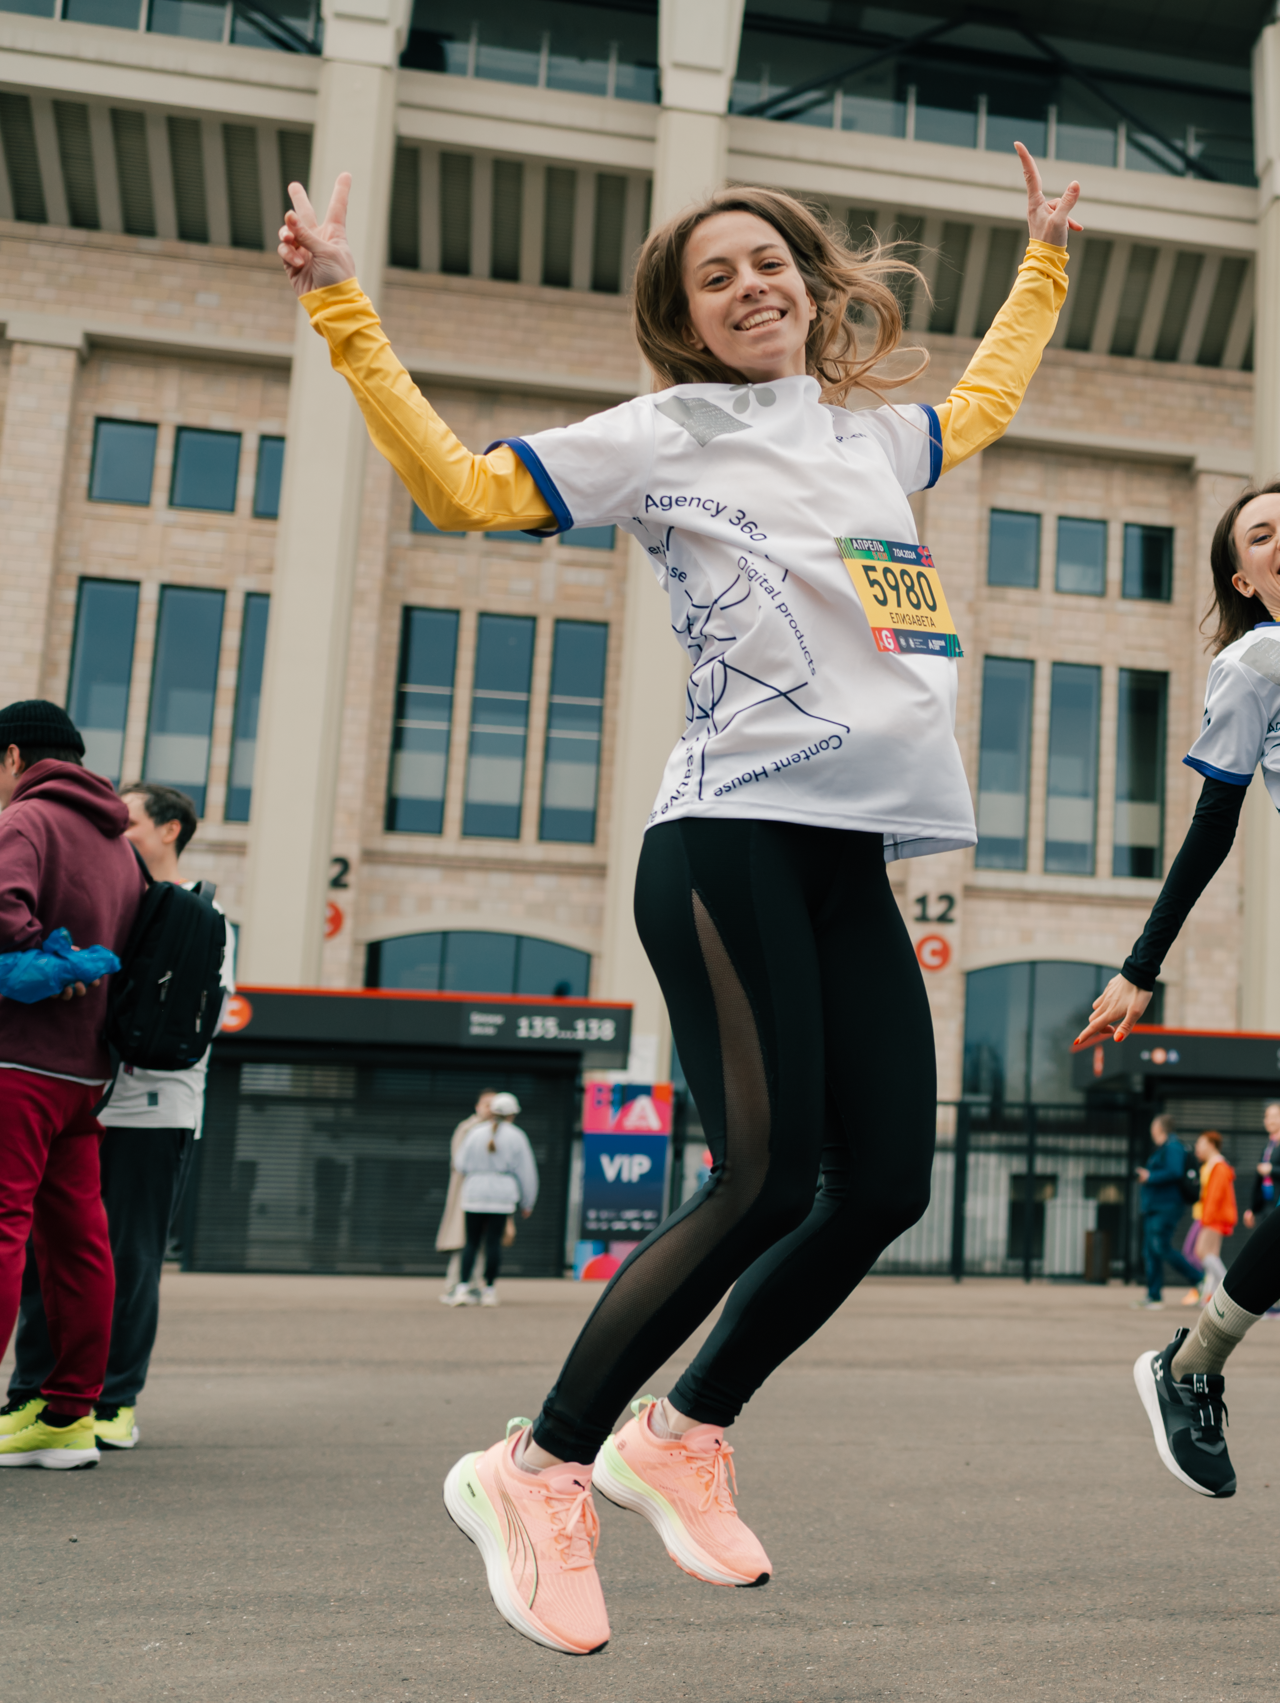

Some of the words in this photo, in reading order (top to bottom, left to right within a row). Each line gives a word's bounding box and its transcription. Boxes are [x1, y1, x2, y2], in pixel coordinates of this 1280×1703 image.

[644, 494, 728, 518] Agency
[728, 509, 768, 542] 360
[852, 539, 884, 552] АПРЕЛЬ
[861, 564, 937, 612] 5980
[737, 556, 782, 601] Digital
[775, 602, 817, 676] products
[889, 612, 936, 628] ЕЛИЗАВЕТА
[881, 629, 895, 650] G
[771, 734, 843, 773] Content
[713, 766, 769, 797] House
[914, 893, 955, 923] 12
[600, 1154, 652, 1183] VIP
